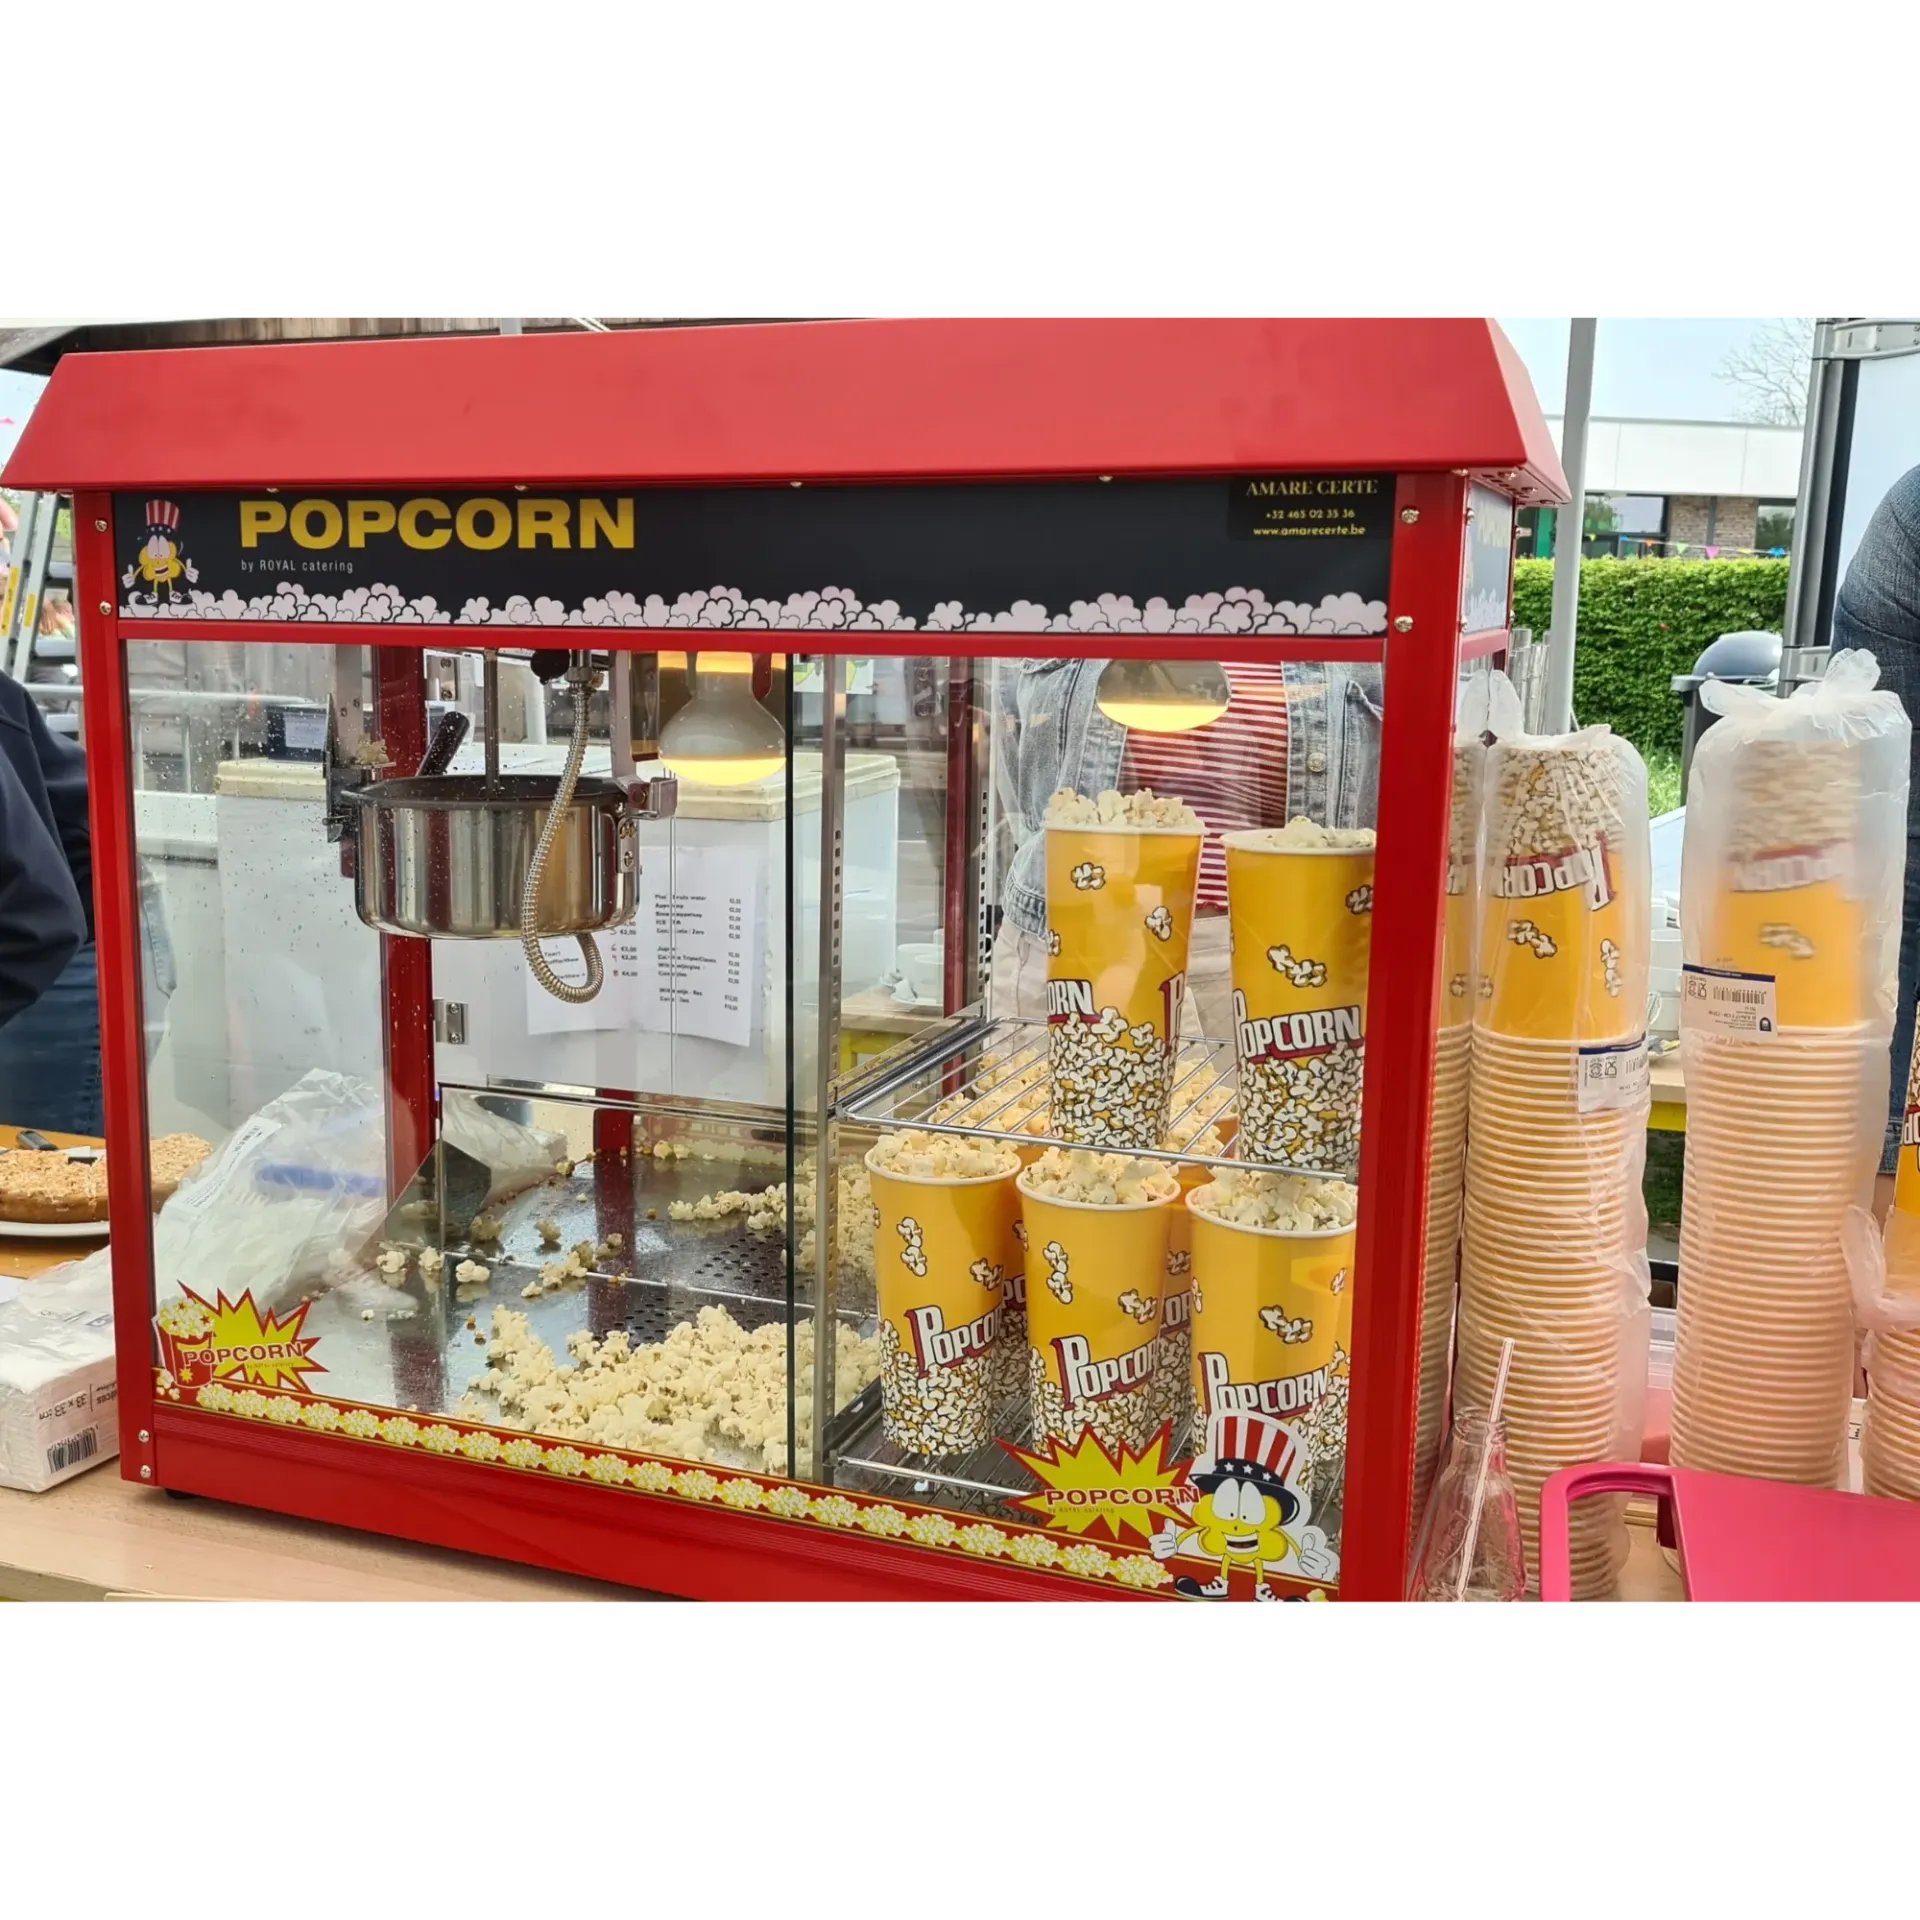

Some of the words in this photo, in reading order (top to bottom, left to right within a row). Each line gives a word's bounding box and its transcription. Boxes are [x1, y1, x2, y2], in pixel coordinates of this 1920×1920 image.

[1246, 480, 1313, 496] AMARE
[1317, 479, 1378, 495] CERTE
[239, 498, 636, 550] POPCORN
[1253, 523, 1366, 536] www.amarecerte.be
[241, 559, 254, 573] by
[259, 559, 296, 571] ROYAL
[302, 560, 353, 574] catering
[182, 1341, 304, 1368] POPCORN
[1045, 1487, 1201, 1506] POPCORN
